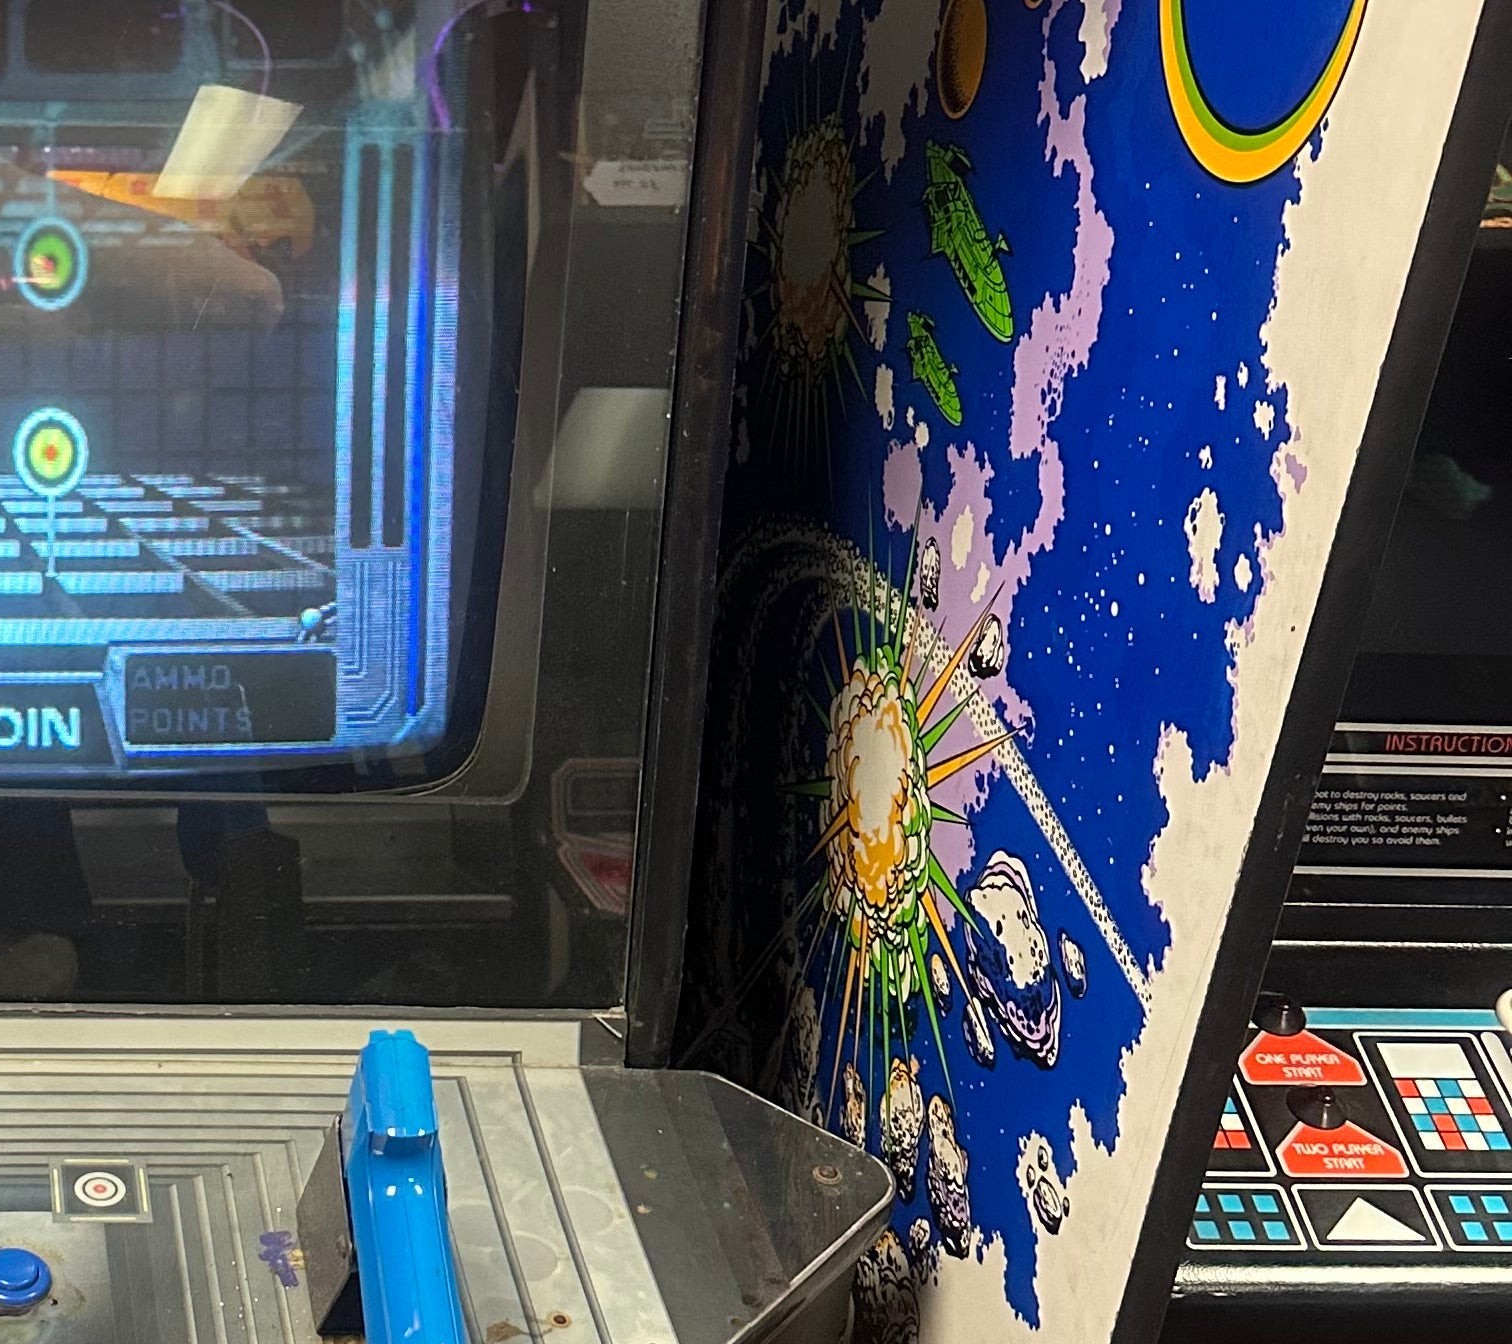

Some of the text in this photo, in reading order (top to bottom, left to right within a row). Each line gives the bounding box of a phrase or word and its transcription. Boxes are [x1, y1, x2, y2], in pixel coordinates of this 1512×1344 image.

[133, 664, 232, 690] AMMO
[132, 707, 253, 735] POINTS
[1330, 790, 1341, 799] to
[1342, 789, 1380, 802] destroy
[1410, 792, 1446, 801] saucers
[1447, 792, 1467, 801] and
[1333, 801, 1359, 813] ships
[1360, 801, 1375, 811] for
[1341, 812, 1363, 822] with
[1436, 813, 1468, 824] bullets
[1325, 824, 1348, 834] your
[1379, 824, 1400, 834] and
[1401, 826, 1434, 836] enemy
[1435, 825, 1460, 836] ships
[1311, 833, 1349, 845] destroy
[1350, 836, 1370, 846] you
[1371, 836, 1384, 844] so
[1385, 835, 1414, 845] avoid
[1255, 1053, 1341, 1065] ONE PLAYER
[1282, 1067, 1324, 1078] START
[1292, 1143, 1385, 1155] TWO PLAYER
[1323, 1158, 1365, 1169] START
